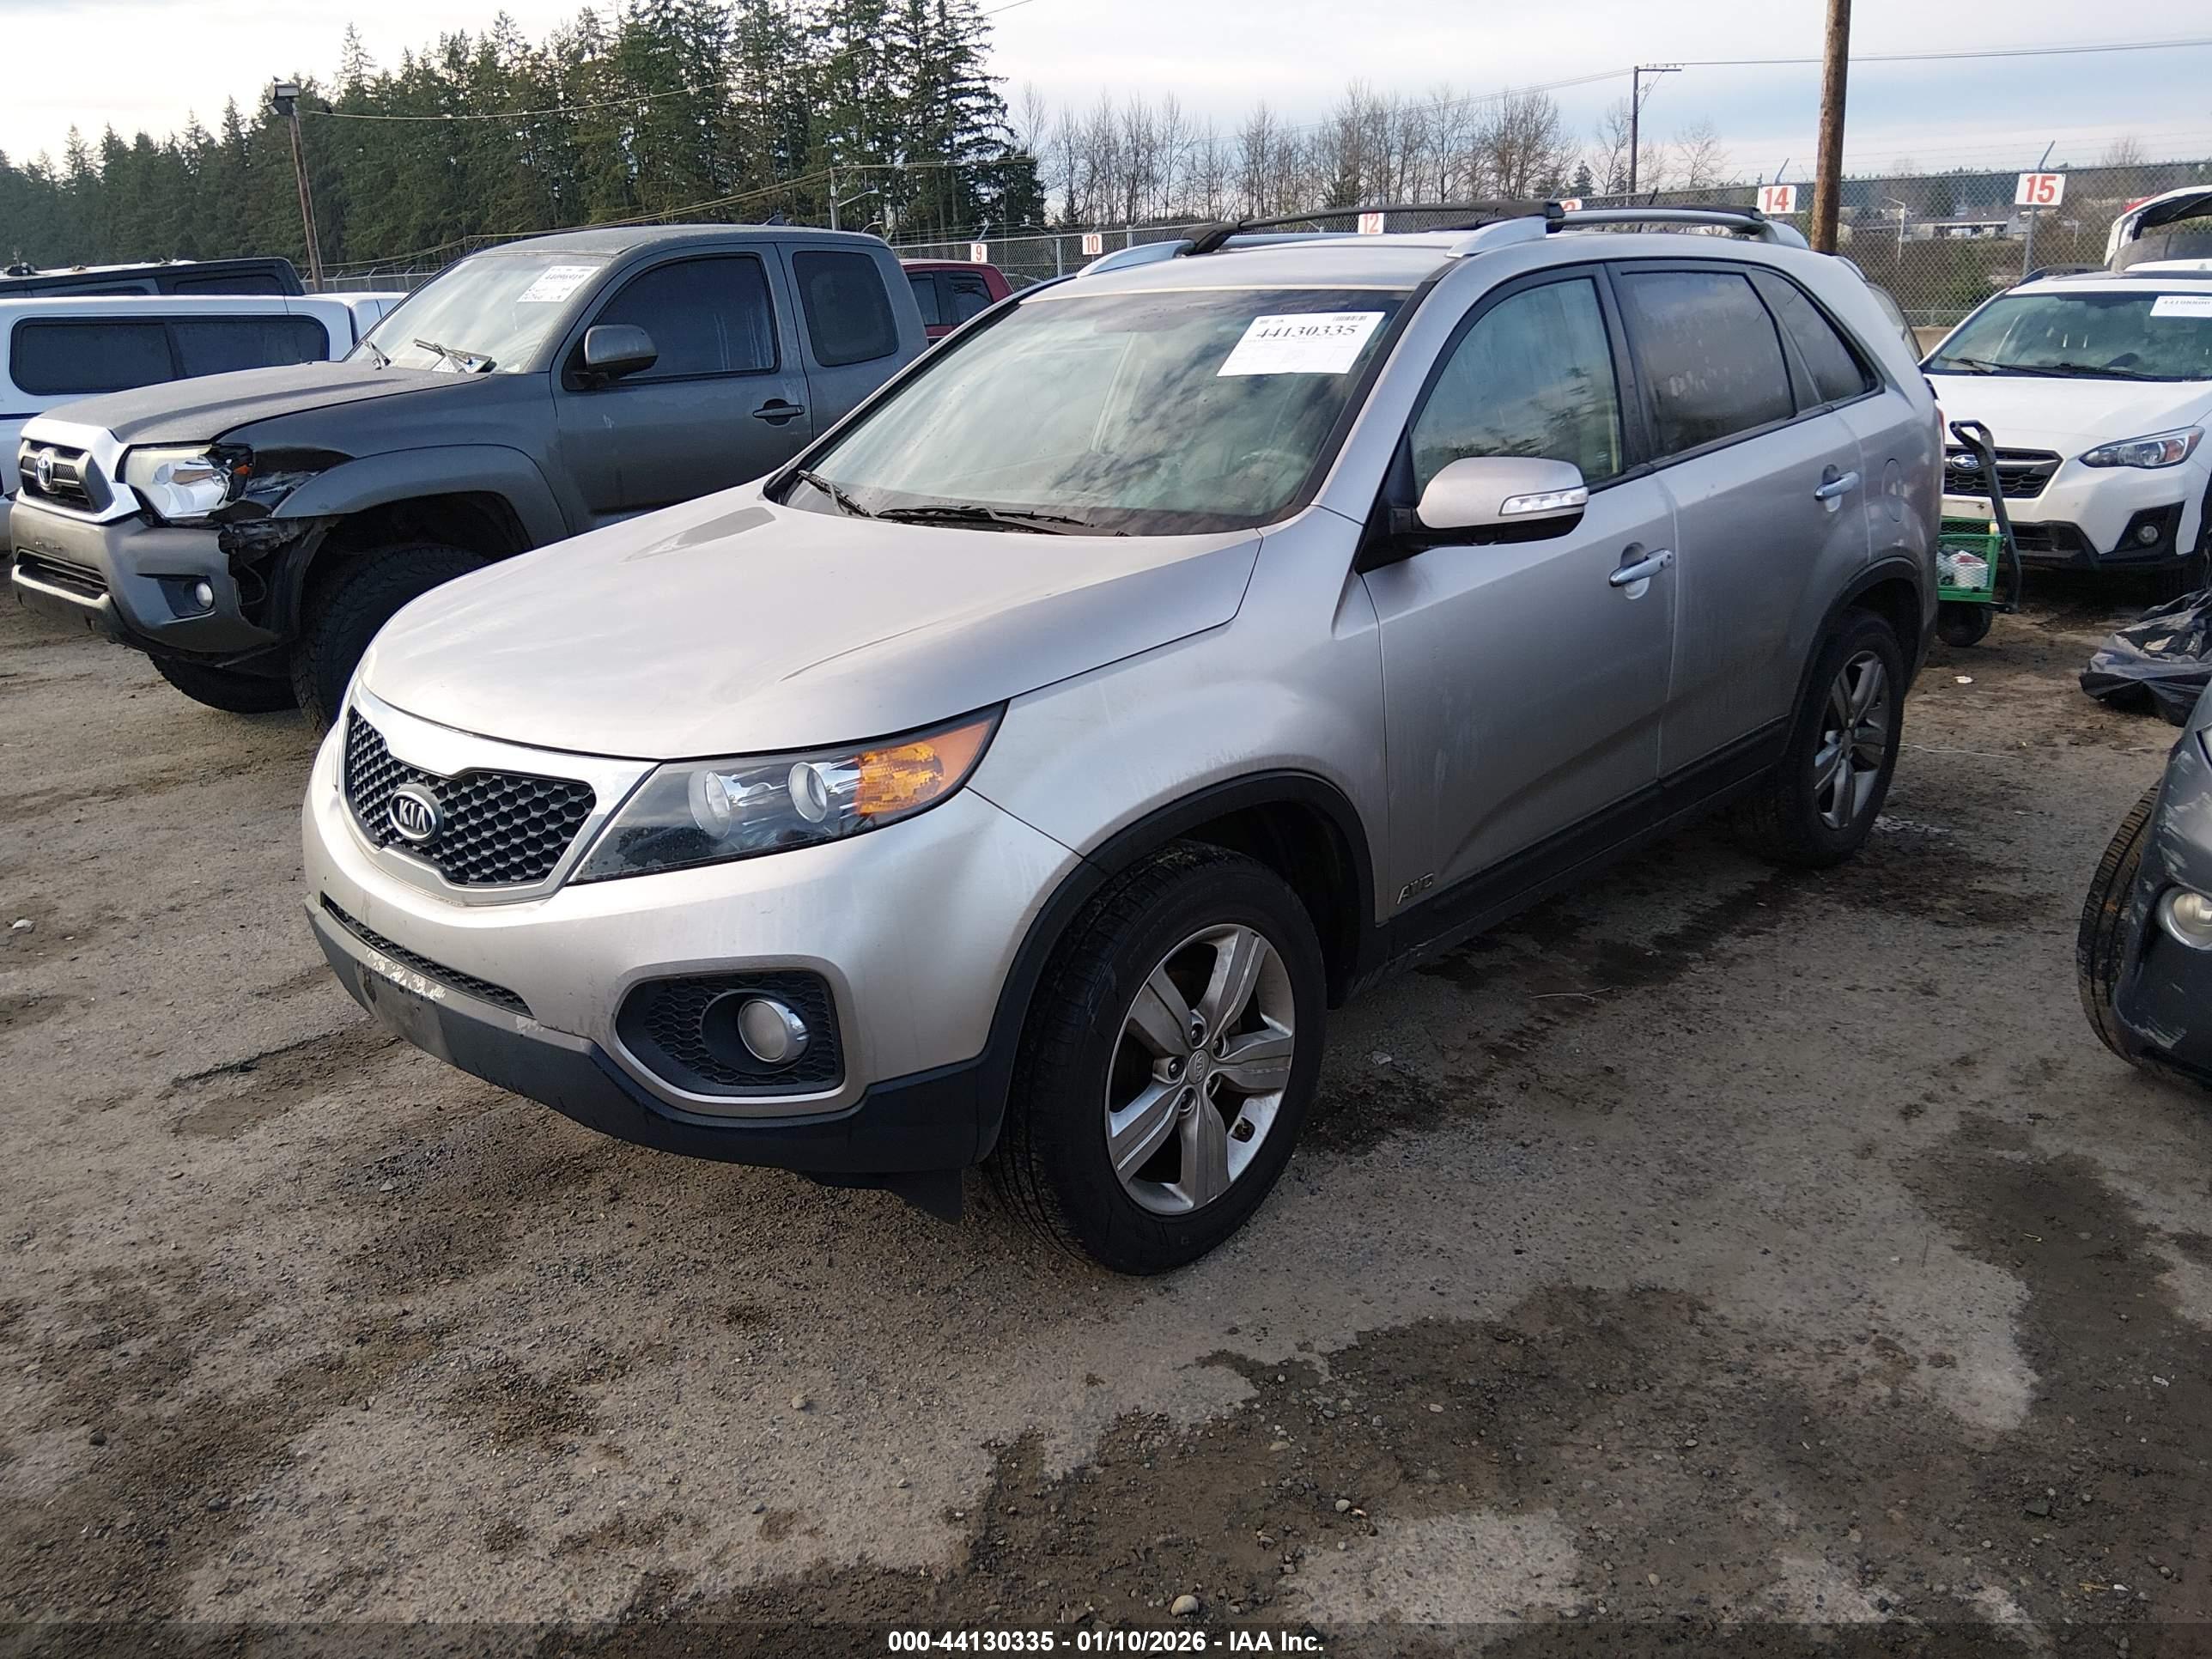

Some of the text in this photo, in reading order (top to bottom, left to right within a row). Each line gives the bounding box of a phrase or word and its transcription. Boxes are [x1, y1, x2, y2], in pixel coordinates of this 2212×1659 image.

[1765, 186, 1790, 212] 14
[2027, 174, 2057, 204] 15
[1362, 213, 1379, 234] 12
[975, 245, 982, 261] 9
[1085, 235, 1099, 253] 10
[1255, 325, 1359, 338] 44130335
[398, 799, 428, 832] KIA
